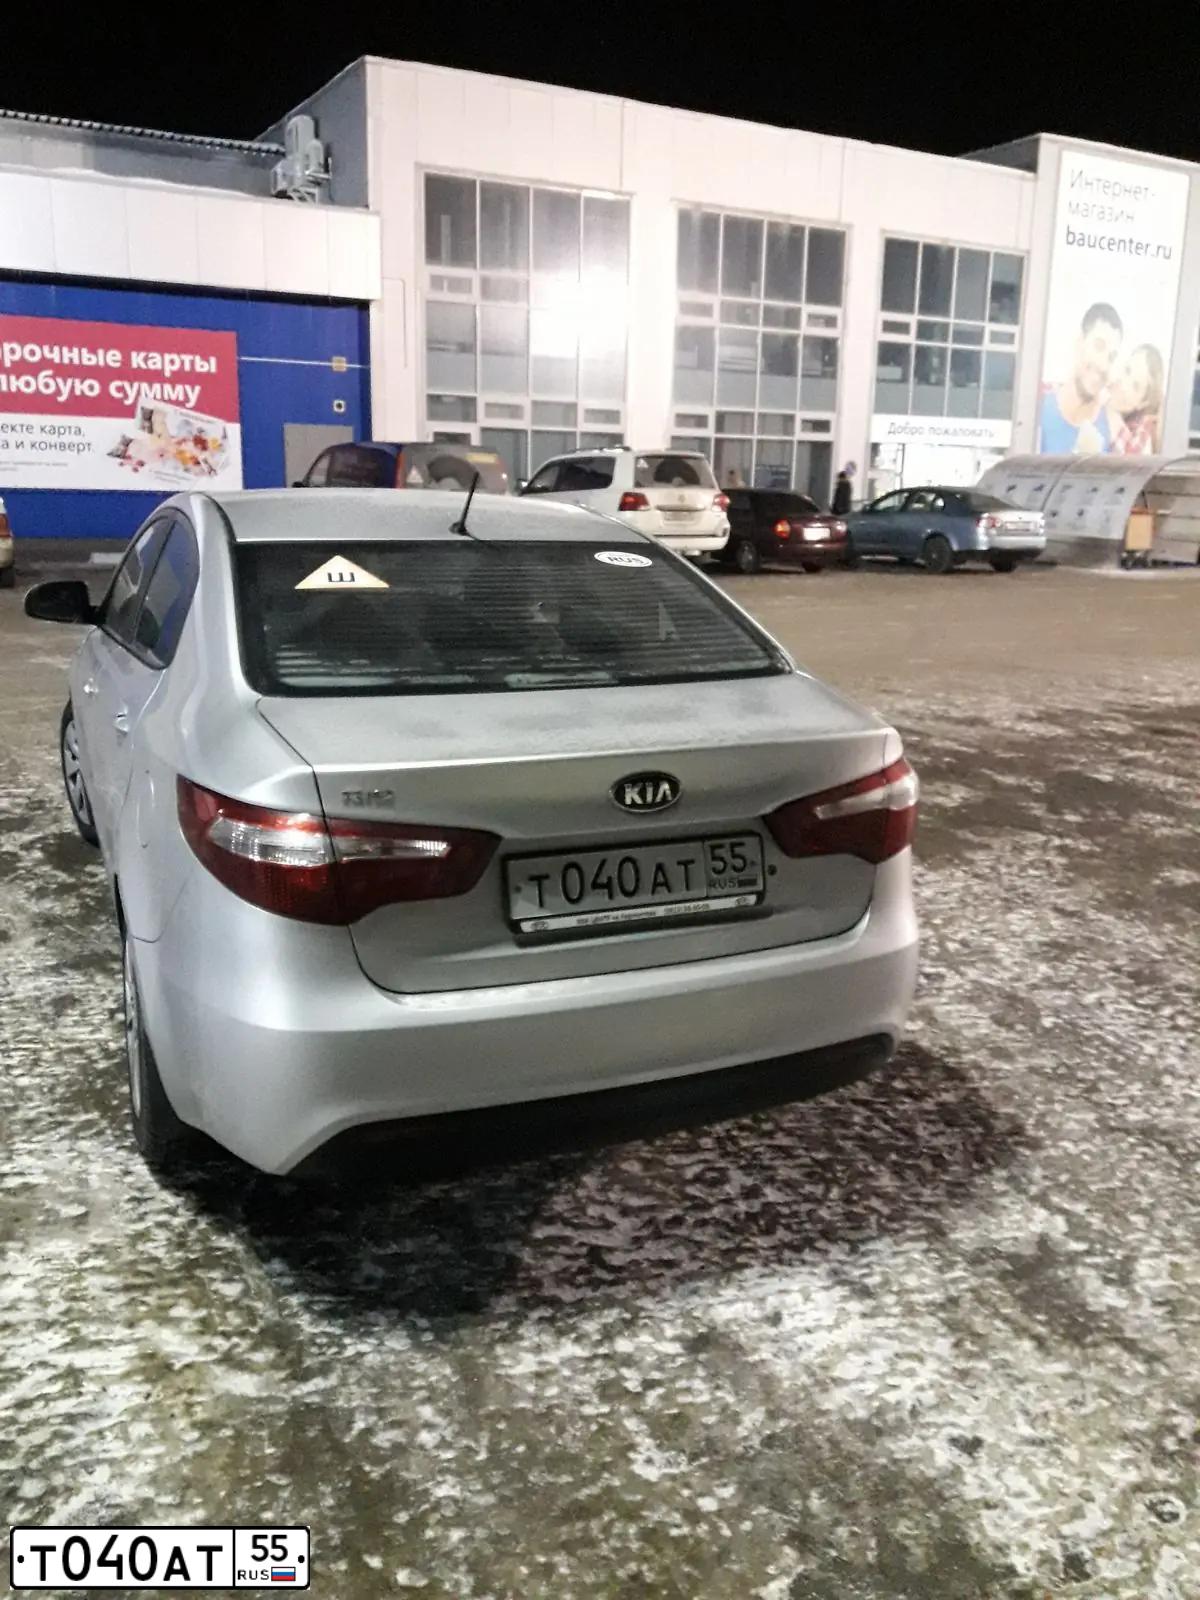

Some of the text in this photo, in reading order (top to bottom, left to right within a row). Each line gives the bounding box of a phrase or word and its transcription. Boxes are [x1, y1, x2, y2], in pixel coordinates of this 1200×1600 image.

[1068, 200, 1134, 222] магазин
[1066, 224, 1172, 260] baucenter.ru
[0, 341, 218, 378] рочные карты
[109, 380, 202, 409] сумму
[40, 424, 86, 438] карта,
[888, 421, 925, 436] Добро
[15, 440, 24, 450] и
[327, 571, 356, 583] Ш
[623, 780, 673, 805] KIA
[528, 841, 748, 909] Т040АТ 55
[708, 878, 737, 890] RUS
